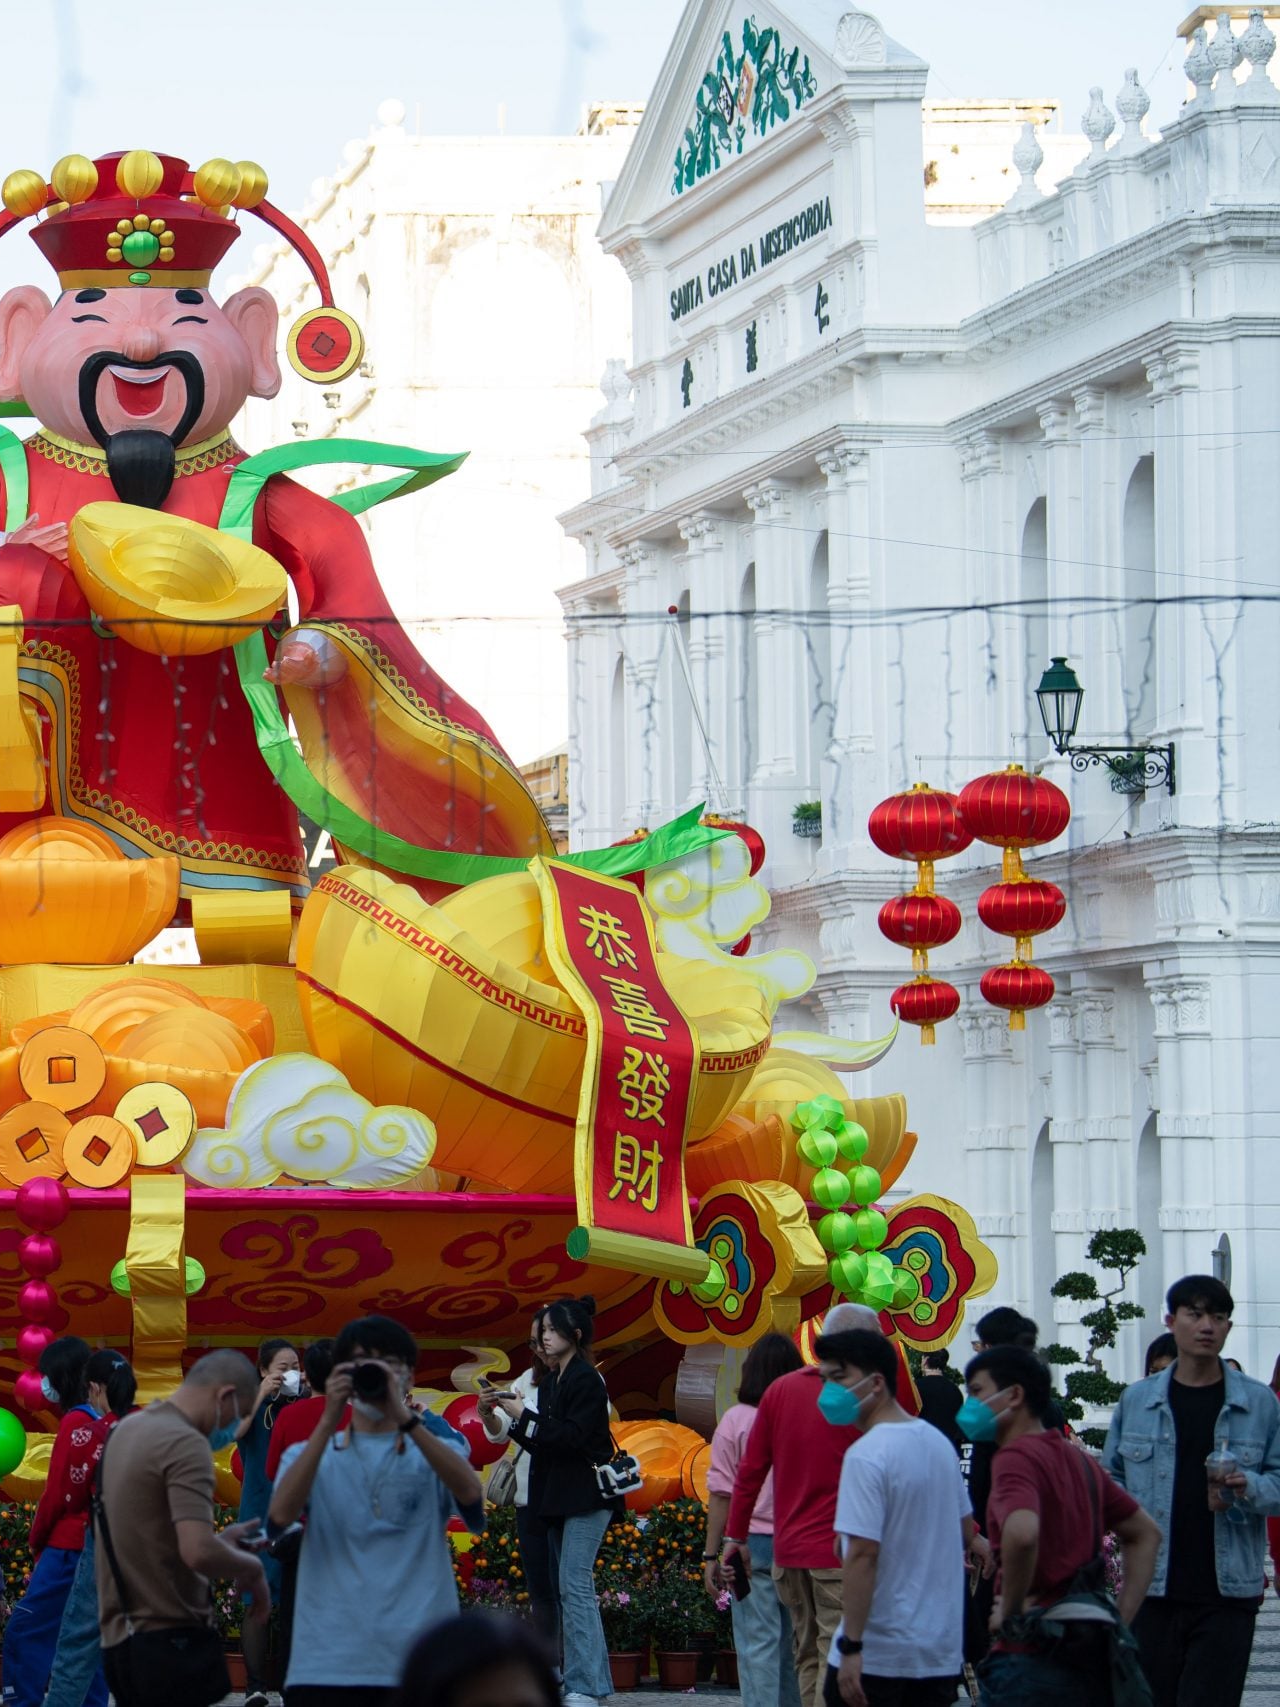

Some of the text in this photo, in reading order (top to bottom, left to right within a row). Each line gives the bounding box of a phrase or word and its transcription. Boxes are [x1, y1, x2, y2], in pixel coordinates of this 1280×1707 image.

[670, 196, 832, 321] SANTA CASA DA MISERICORDIA
[578, 904, 670, 1213] 恭喜發財
